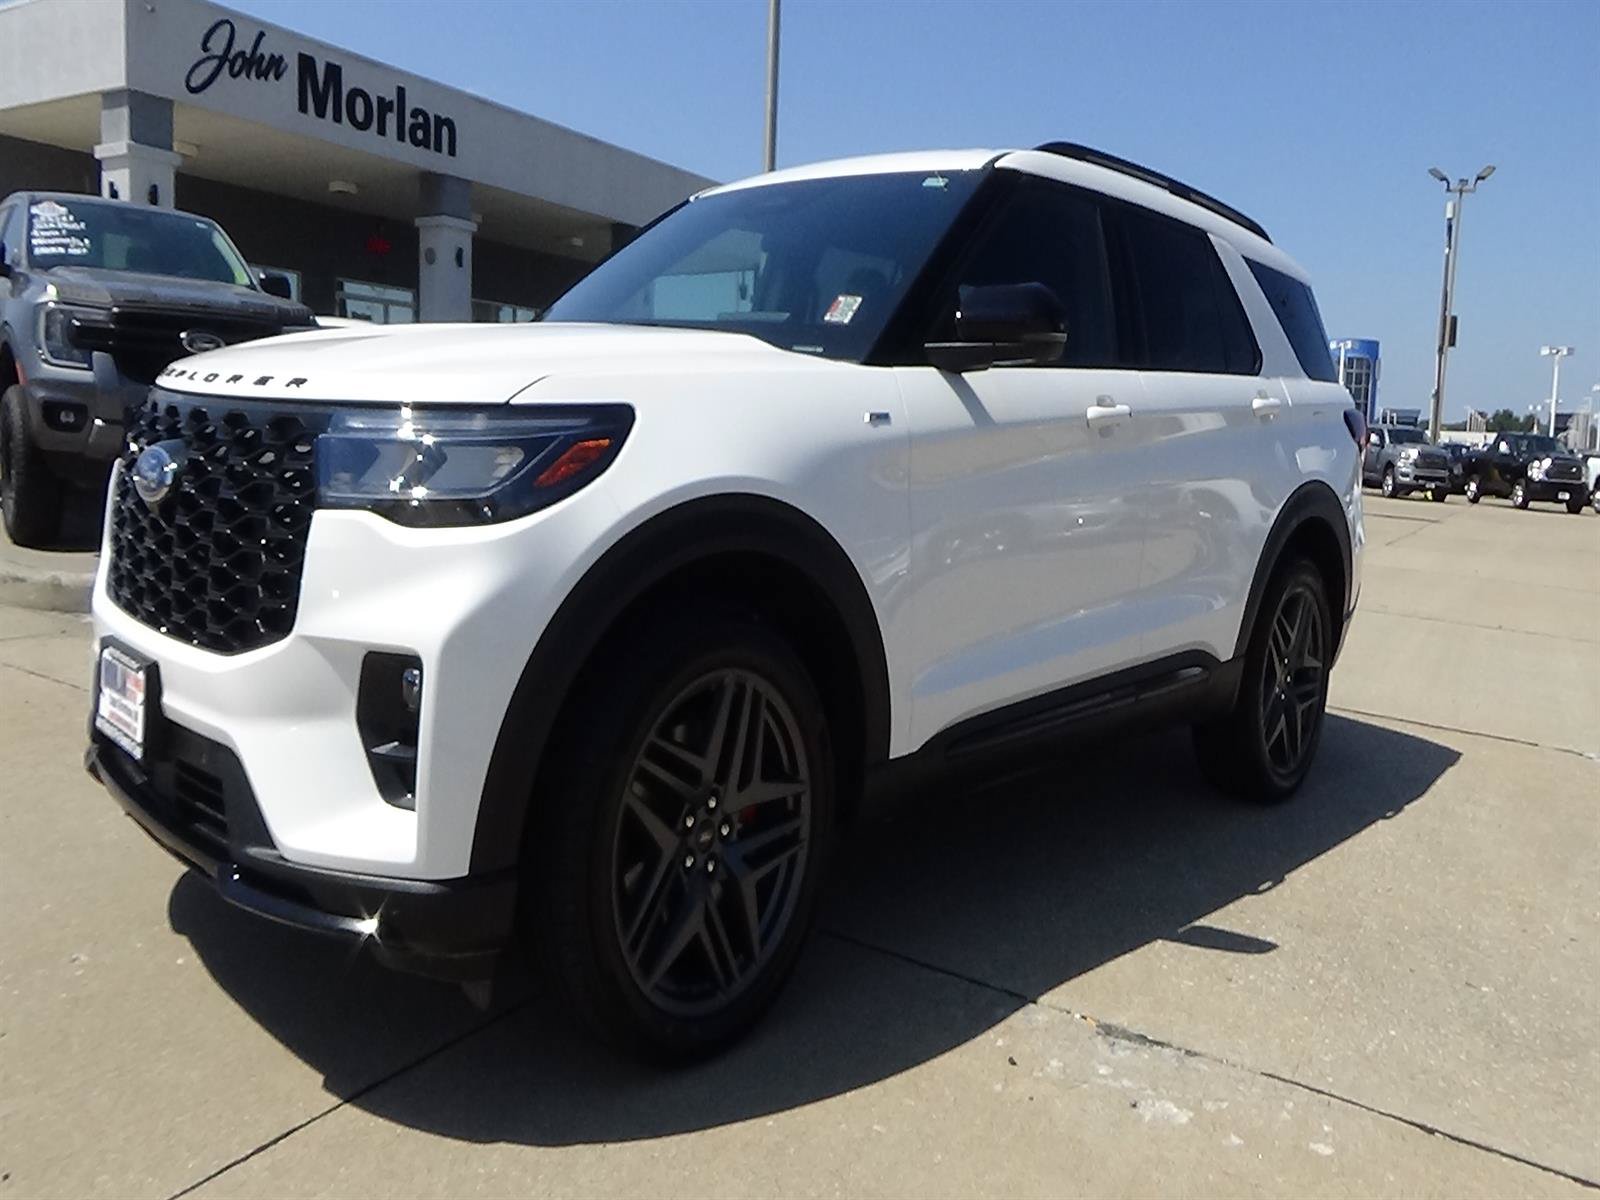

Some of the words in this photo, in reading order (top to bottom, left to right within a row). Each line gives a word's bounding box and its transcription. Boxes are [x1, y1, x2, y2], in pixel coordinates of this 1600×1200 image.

[185, 19, 288, 94] John
[298, 51, 457, 157] Morlan
[163, 366, 308, 388] XPLORER
